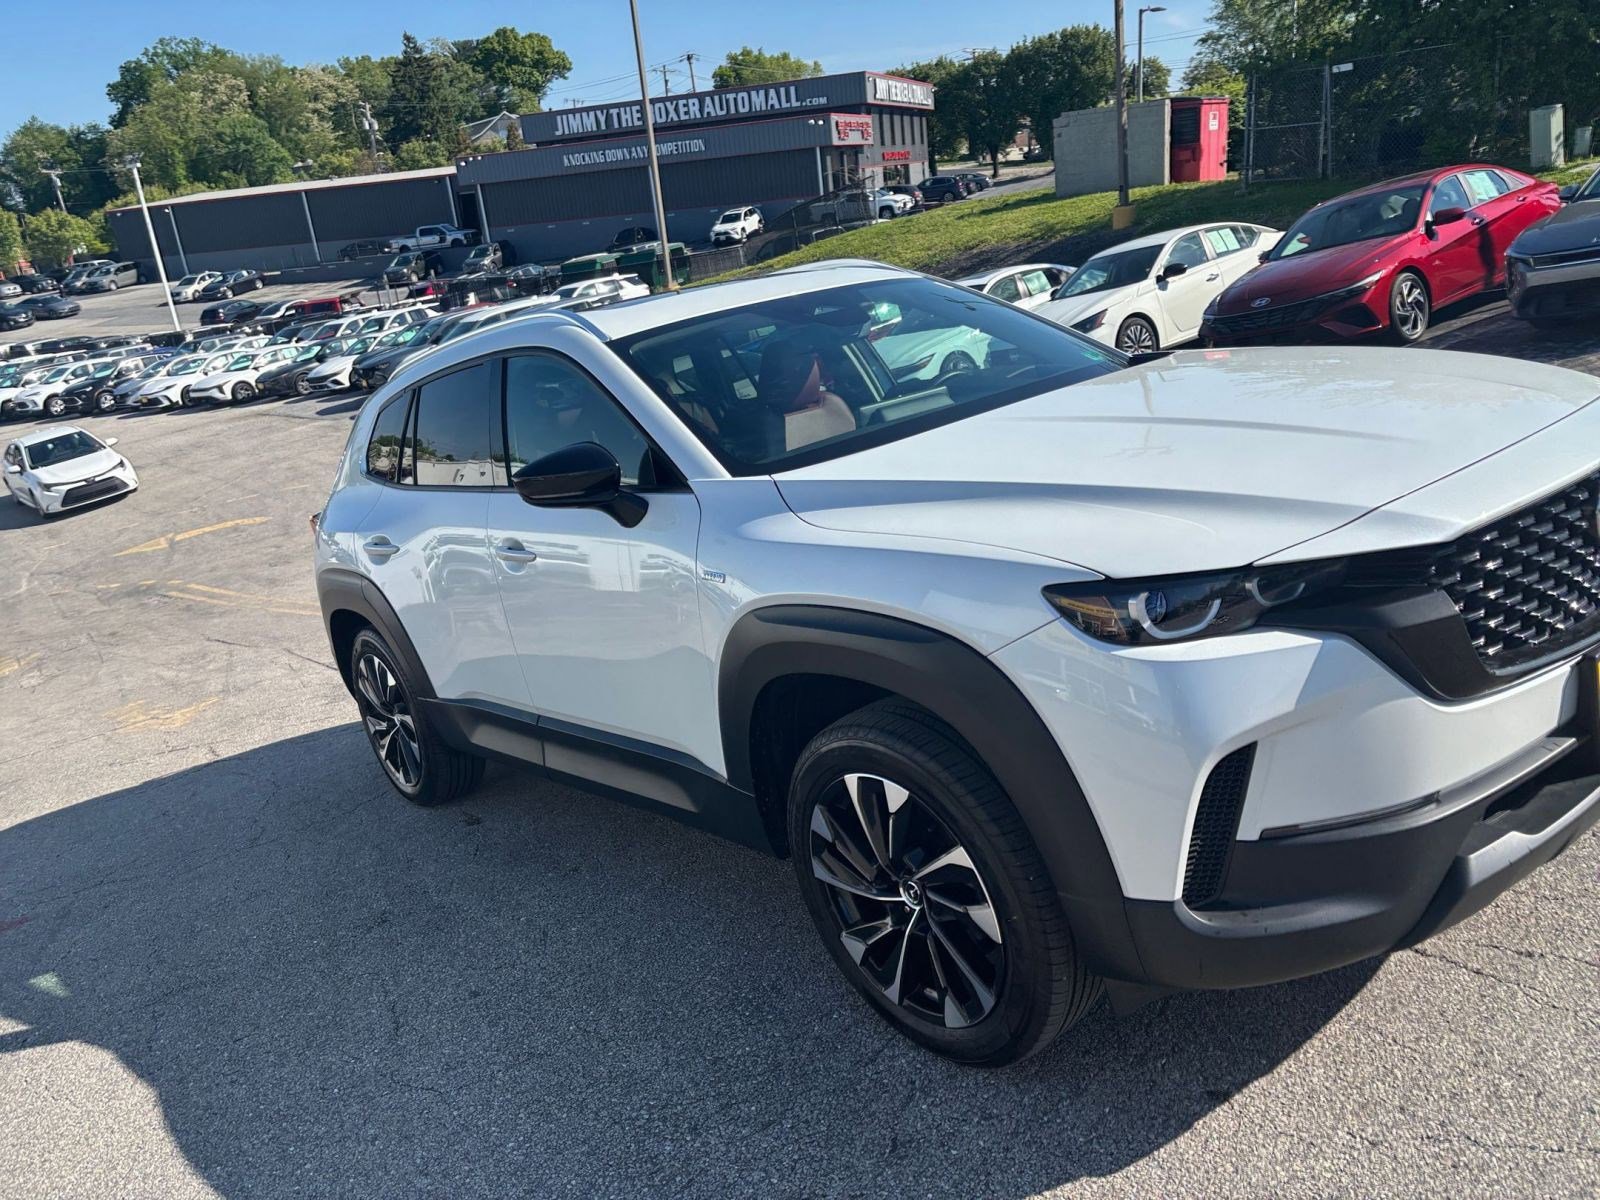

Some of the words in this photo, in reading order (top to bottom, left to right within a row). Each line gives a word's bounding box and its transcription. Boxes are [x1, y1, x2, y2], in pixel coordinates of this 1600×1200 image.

[555, 109, 608, 136] JIMMY
[609, 105, 643, 129] THE
[563, 150, 606, 167] KNOCKING
[606, 147, 631, 162] DOWN
[631, 145, 649, 159] ANY
[655, 138, 706, 157] OMPETITION
